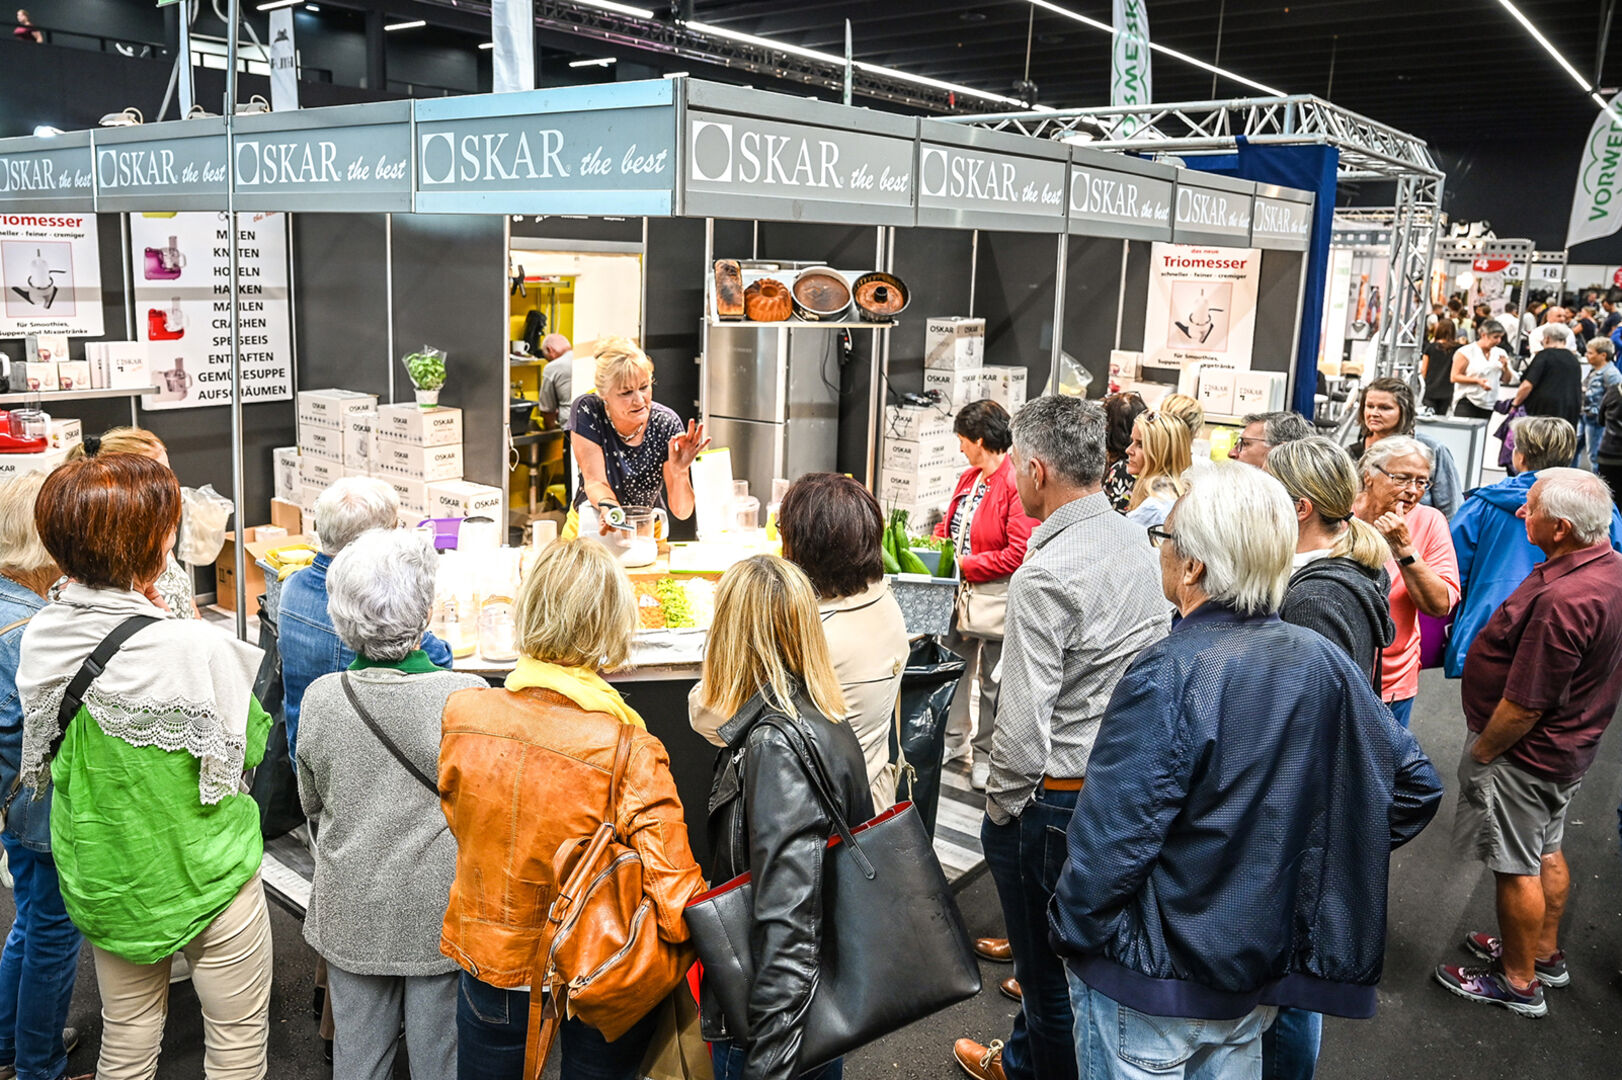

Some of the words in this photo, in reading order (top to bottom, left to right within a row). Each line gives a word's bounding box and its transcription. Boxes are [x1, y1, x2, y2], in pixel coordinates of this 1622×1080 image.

[422, 129, 572, 185] OSKAR
[579, 146, 612, 177] the
[621, 143, 668, 175] best
[692, 120, 843, 188] OSKAR
[850, 163, 873, 190] the
[879, 165, 910, 193] best
[1588, 101, 1622, 221] VORWE
[236, 140, 341, 185] OSKAR
[347, 156, 369, 181] the
[374, 154, 407, 180] best
[99, 149, 178, 188] OSKAR
[182, 162, 199, 183] the
[202, 161, 226, 182] best
[59, 170, 72, 188] the
[74, 169, 92, 188] best
[921, 148, 1018, 202] OSKAR
[1022, 181, 1039, 204] the
[1041, 182, 1063, 206] best
[1071, 171, 1139, 218] OSKAR
[1140, 200, 1153, 218] the
[1154, 200, 1170, 220] best
[1176, 188, 1226, 227] OSKAR
[0, 215, 84, 228] iomesser
[1252, 201, 1290, 233] OSKAR
[216, 229, 256, 241] MEN
[213, 247, 260, 258] KNTEN
[1163, 255, 1248, 269] Triomesser
[213, 266, 260, 277] HOELN
[1542, 268, 1558, 278] 18
[213, 284, 262, 295] HAKEN
[213, 301, 264, 311] MALEN
[930, 325, 954, 334] OSKAR
[212, 335, 269, 346] SPESEEIS
[208, 352, 274, 364] ENTAFTEN
[198, 368, 286, 382] GEMÜESUPPE
[927, 375, 951, 383] OSKAR
[198, 385, 287, 400] AUFSÄUMEN
[393, 417, 408, 425] OSKAR
[433, 418, 454, 427] OSKAR
[353, 423, 371, 433] OSKAR
[394, 451, 409, 459] OSKAR
[893, 446, 912, 454] OSKAR
[435, 452, 455, 461] OSKAR
[281, 458, 296, 468] OSKAR
[890, 477, 910, 485] OSKAR
[440, 496, 460, 507] OSKAR
[474, 498, 500, 509] OSKAR
